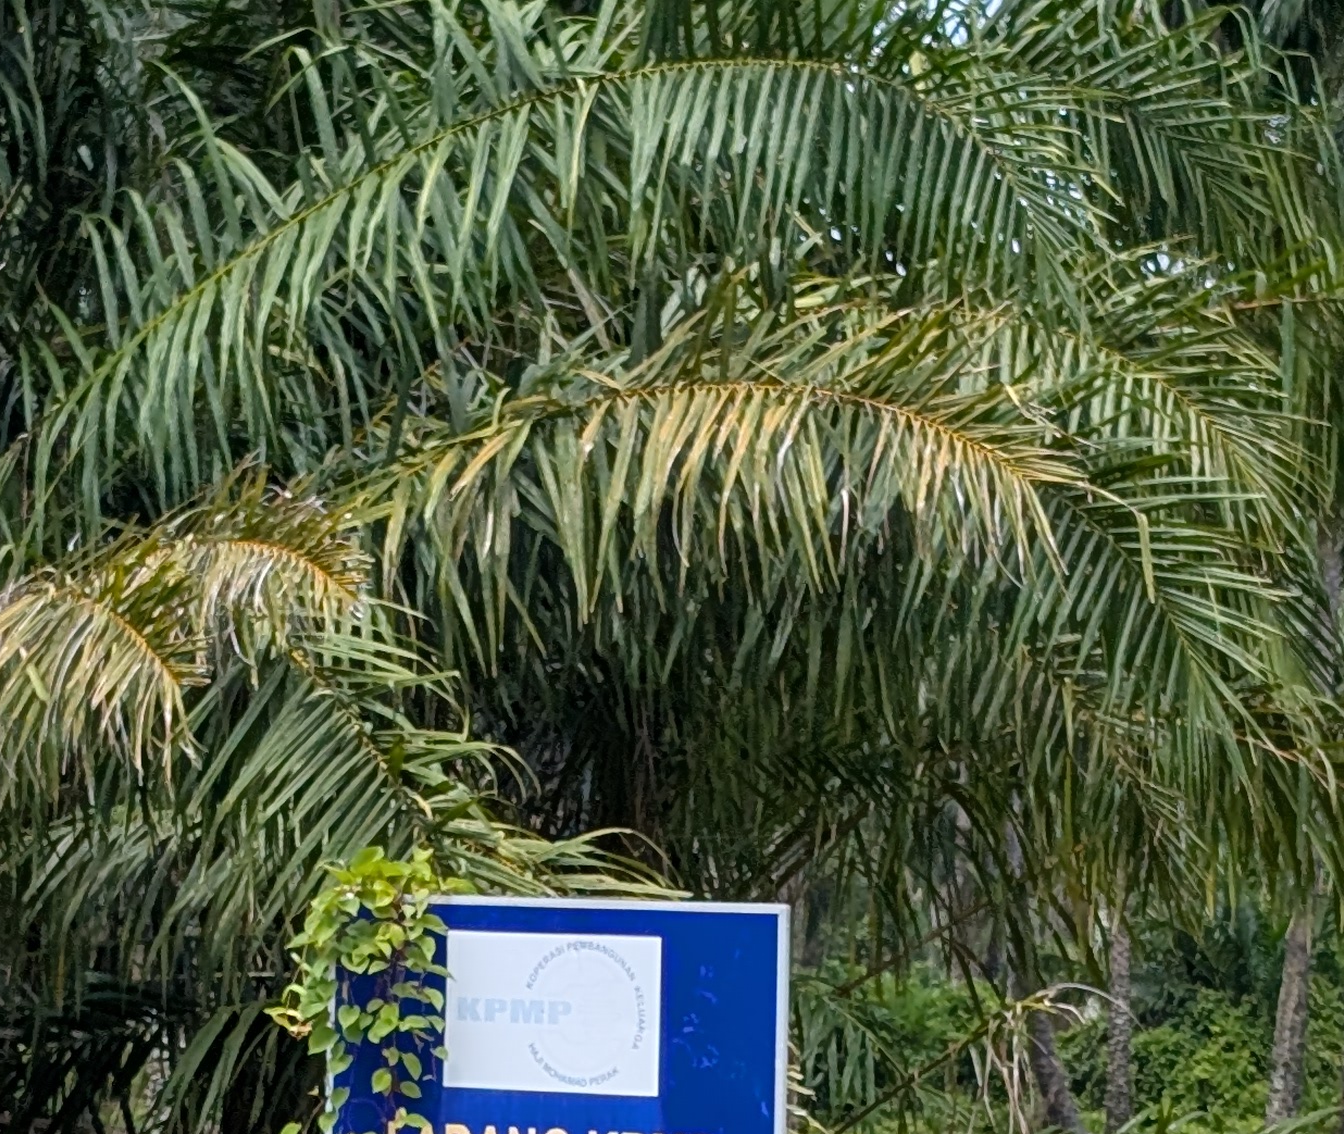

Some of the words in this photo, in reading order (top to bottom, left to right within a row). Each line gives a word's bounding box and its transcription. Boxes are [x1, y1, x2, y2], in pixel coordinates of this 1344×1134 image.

[526, 945, 565, 990] KOPERASI
[566, 941, 636, 981] PEMBANGUNAN
[457, 997, 572, 1025] KPMP
[528, 1042, 545, 1067] HAJI
[589, 1066, 619, 1087] PERAK
